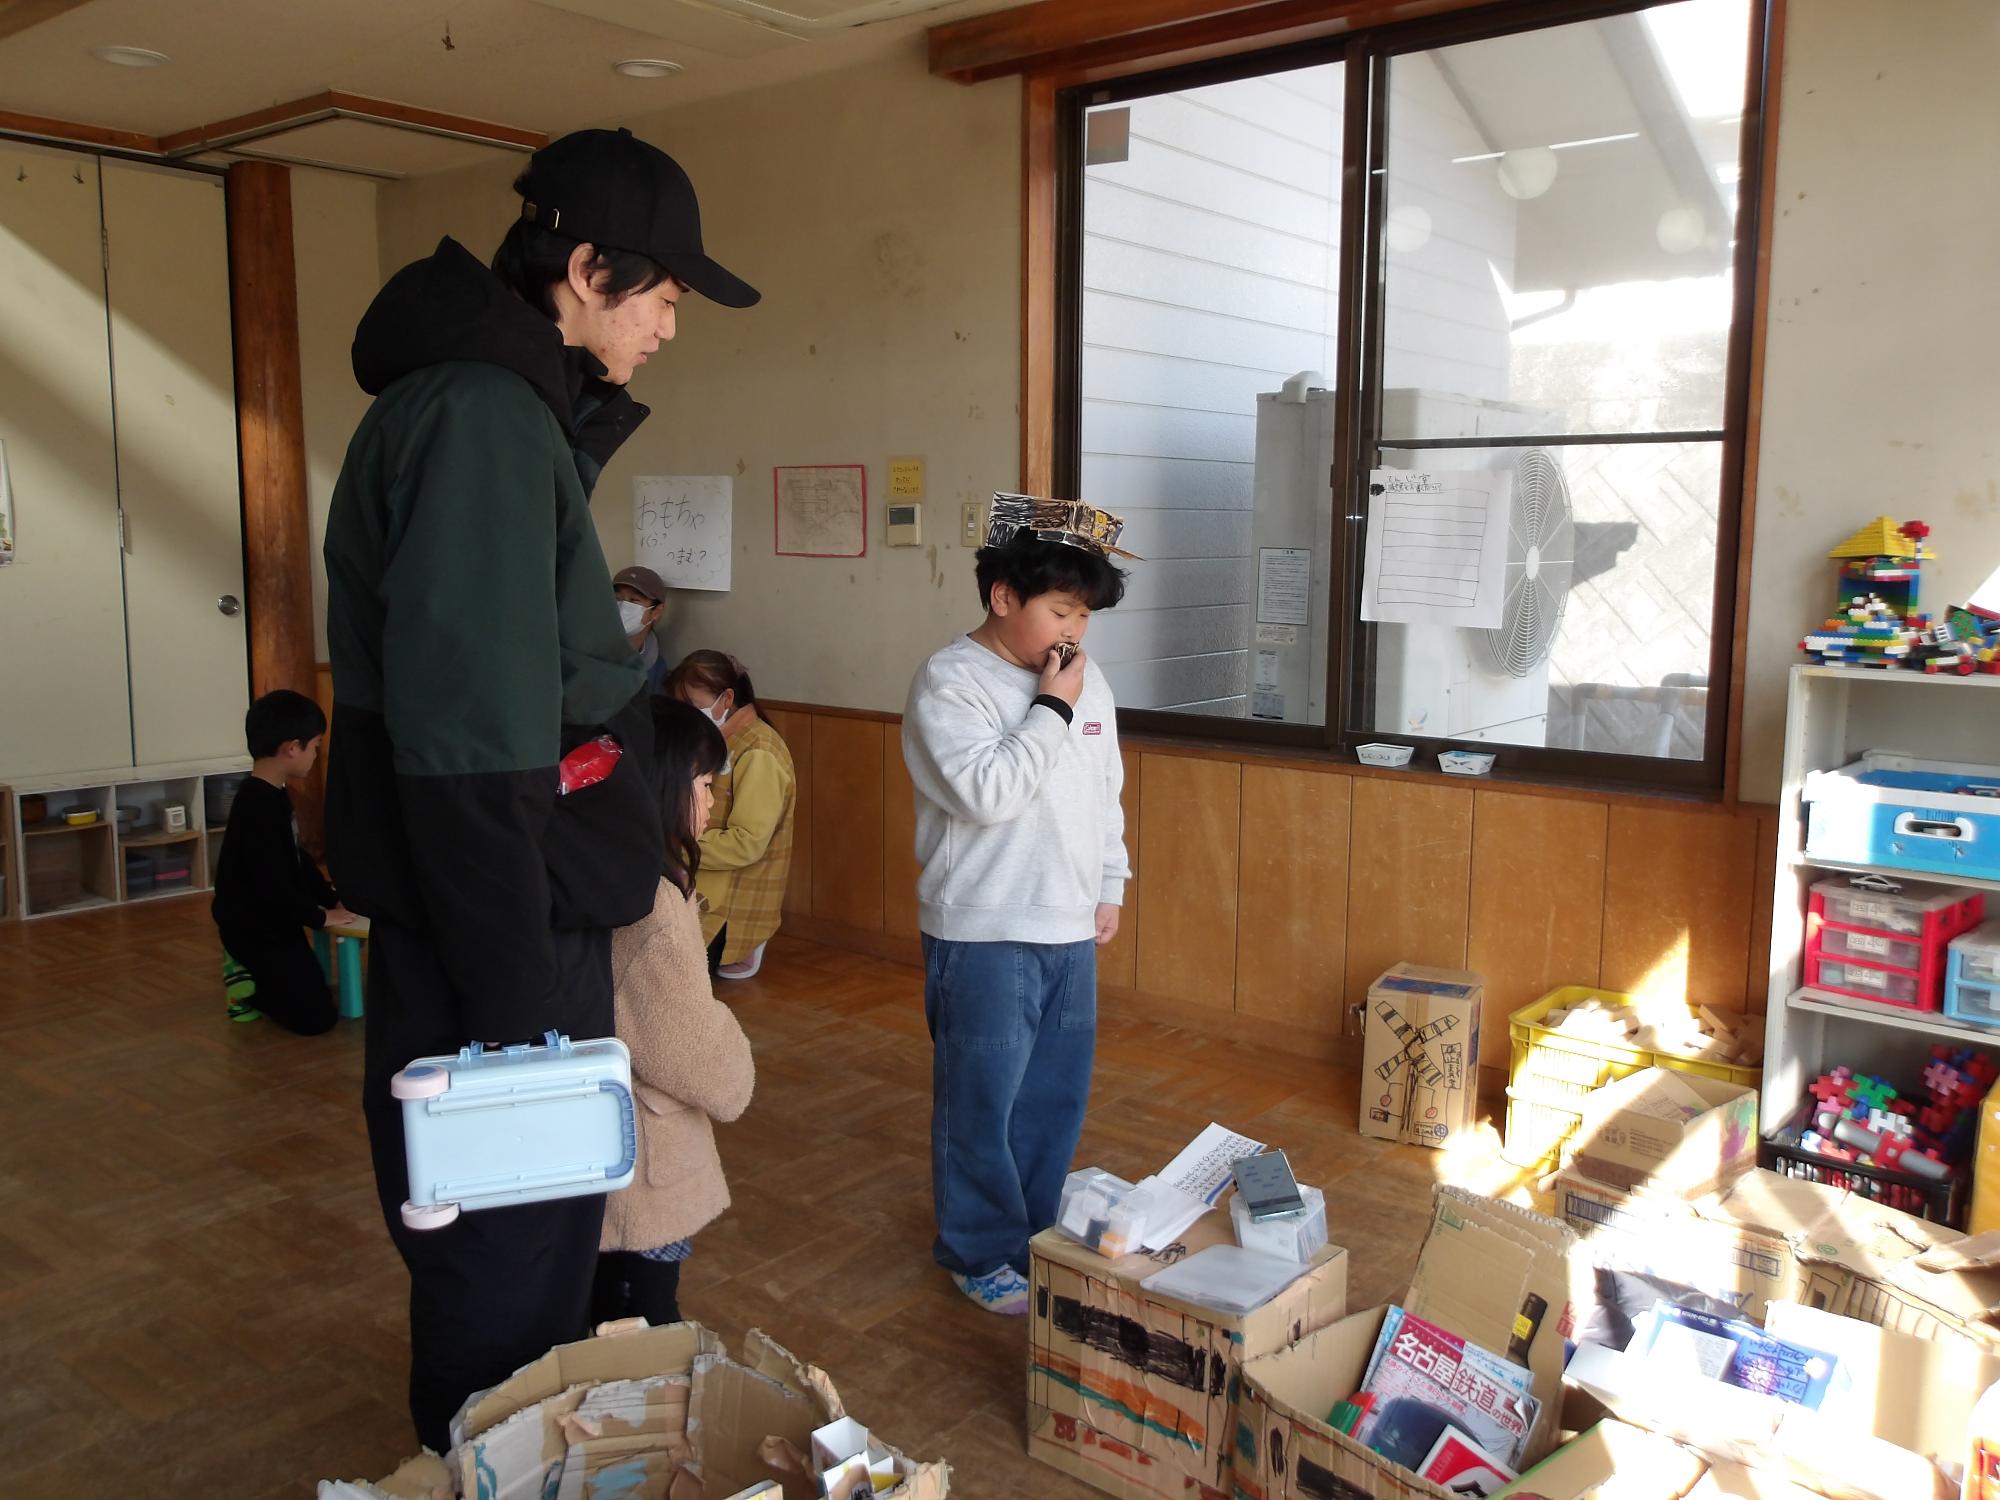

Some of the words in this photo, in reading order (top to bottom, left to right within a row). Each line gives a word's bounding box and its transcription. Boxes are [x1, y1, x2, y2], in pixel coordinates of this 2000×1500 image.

[637, 495, 705, 531] おもちゃ
[1396, 1333, 1525, 1434] 名古屋鉄道の世界
